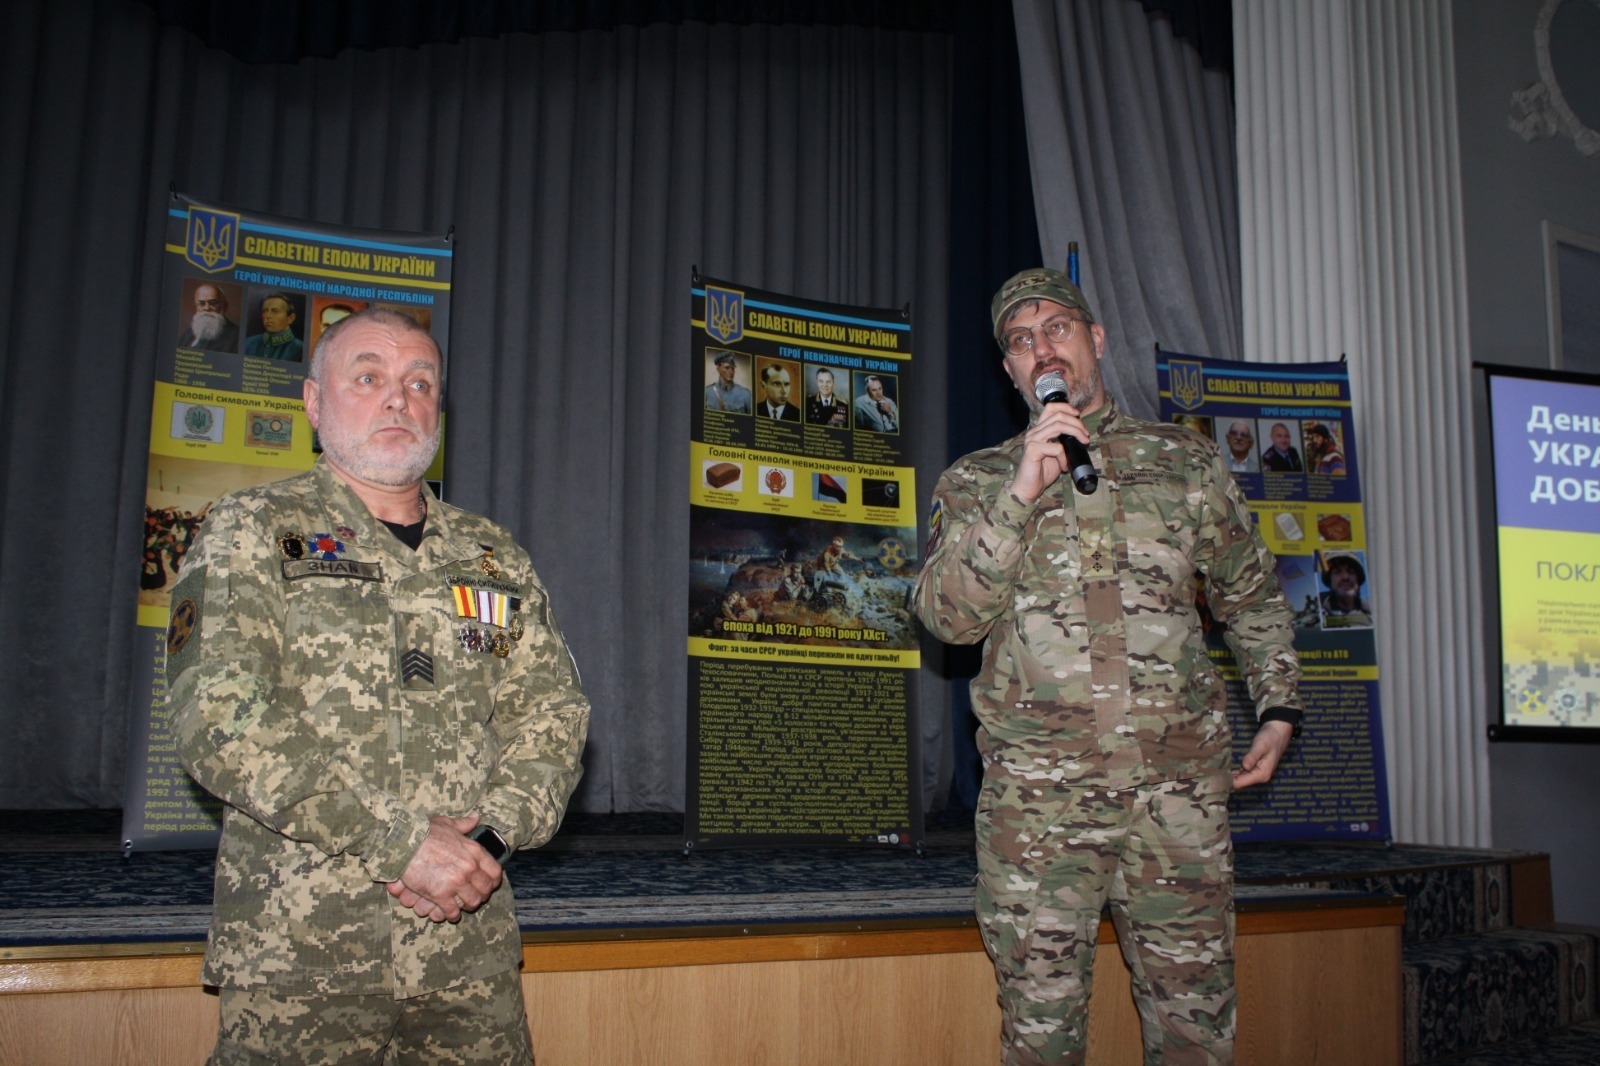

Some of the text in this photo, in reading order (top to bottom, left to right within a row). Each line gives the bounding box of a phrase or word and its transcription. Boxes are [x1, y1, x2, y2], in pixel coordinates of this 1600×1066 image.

[244, 236, 435, 277] СЛАВЕТНІ ЕПОХИ УКРАЇНИ
[234, 270, 434, 304] ГЕРОЇ УКРАЇНСЬКОЇ НАРОДНОЇ РЕСПУБЛІКИ
[749, 311, 898, 349] СЛАВЕТНІ ЕПОХИ УКРАЇНИ
[779, 346, 899, 372] ГЕРОЇ НЕВИЗНАЧЕНОЇ УКРАЇНИ
[1207, 379, 1340, 397] СЛАВЕТНІ ЕПОХИ УКРАЇНИ
[175, 389, 214, 402] Головні
[216, 396, 261, 407] символи
[709, 448, 894, 479] Головні символи невизначеної України
[1530, 475, 1600, 504] ДОБ
[1537, 561, 1600, 582] ПОКЛ
[723, 621, 754, 633] епоха
[756, 623, 773, 636] від
[775, 623, 797, 636] 1921
[799, 626, 812, 638] до
[815, 626, 837, 638] 1991
[838, 628, 862, 642] року
[709, 643, 729, 652] Факт:
[731, 645, 739, 653] за
[741, 646, 757, 654] часи
[759, 647, 776, 655] СРСР
[778, 648, 807, 658] українці
[809, 650, 845, 660] пережили
[856, 653, 872, 661] одну
[874, 653, 900, 662] ганьбу!
[1333, 650, 1349, 658] АТО
[699, 661, 816, 674] Період перебування українських
[761, 671, 786, 679] Польщі
[719, 682, 759, 691] української
[745, 677, 799, 687] неоднозначний
[759, 691, 776, 699] були
[751, 698, 803, 707] Україна добре
[699, 702, 830, 714] Голодомор 1932-1933рр спеціально
[699, 716, 734, 724] стрільний
[699, 729, 745, 737] Сталінського
[752, 724, 787, 732] Мільйони
[699, 736, 723, 744] Сибіру
[724, 743, 759, 752] 1944року.
[761, 745, 786, 753] Період
[766, 759, 798, 767] українців
[748, 765, 857, 775] Україна боротьбу
[146, 778, 171, 787] уряд
[742, 792, 785, 800] державність
[144, 810, 182, 820] Україна
[748, 806, 781, 814] українців
[144, 823, 216, 832] період російсь
